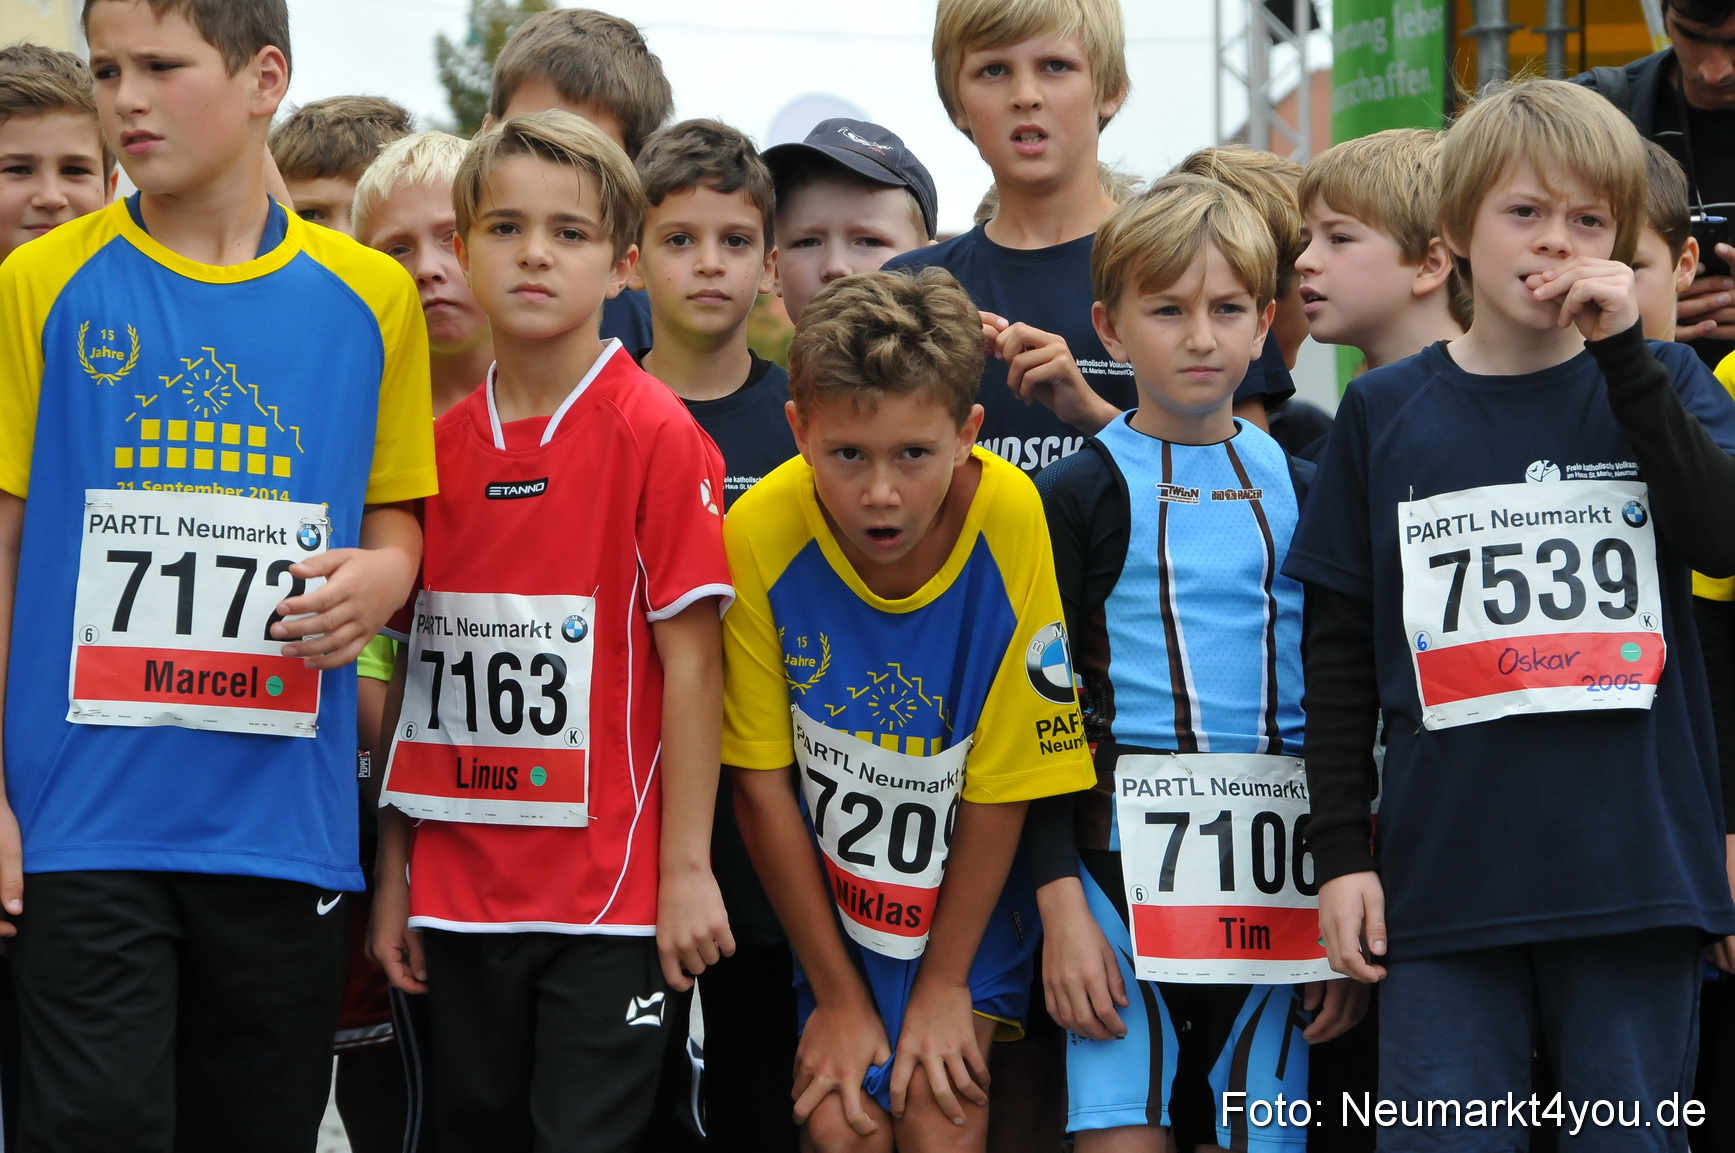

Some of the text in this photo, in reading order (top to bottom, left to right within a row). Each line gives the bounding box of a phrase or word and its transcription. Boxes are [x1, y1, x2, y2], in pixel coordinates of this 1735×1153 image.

[101, 328, 115, 341] 15
[89, 346, 125, 361] Jahre
[116, 480, 290, 502] 21 September 2014
[489, 482, 545, 496] STANNO
[88, 514, 287, 545] PARTL Neumarkt
[1406, 505, 1612, 545] PARTL Neumarkt
[106, 549, 307, 642] 7172
[1429, 537, 1639, 634] 7539
[85, 628, 93, 642] 6
[416, 613, 552, 640] PARTL Neumarkt
[797, 636, 807, 648] 15
[1417, 633, 1428, 651] 6
[784, 654, 816, 668] Jahre
[1498, 647, 1581, 675] Oskar
[144, 659, 257, 698] Marcel
[1581, 673, 1643, 692] 2005
[420, 649, 568, 737] 7163
[406, 725, 413, 738] 6
[570, 730, 578, 744] K
[795, 724, 960, 795] PARTL Neumarkt
[456, 757, 518, 790] Linus
[1122, 777, 1307, 800] PARTL Neumarkt
[1145, 810, 1319, 897] 7106
[835, 874, 922, 929] Niklas
[1136, 887, 1143, 901] 6
[1218, 917, 1271, 950] Tim
